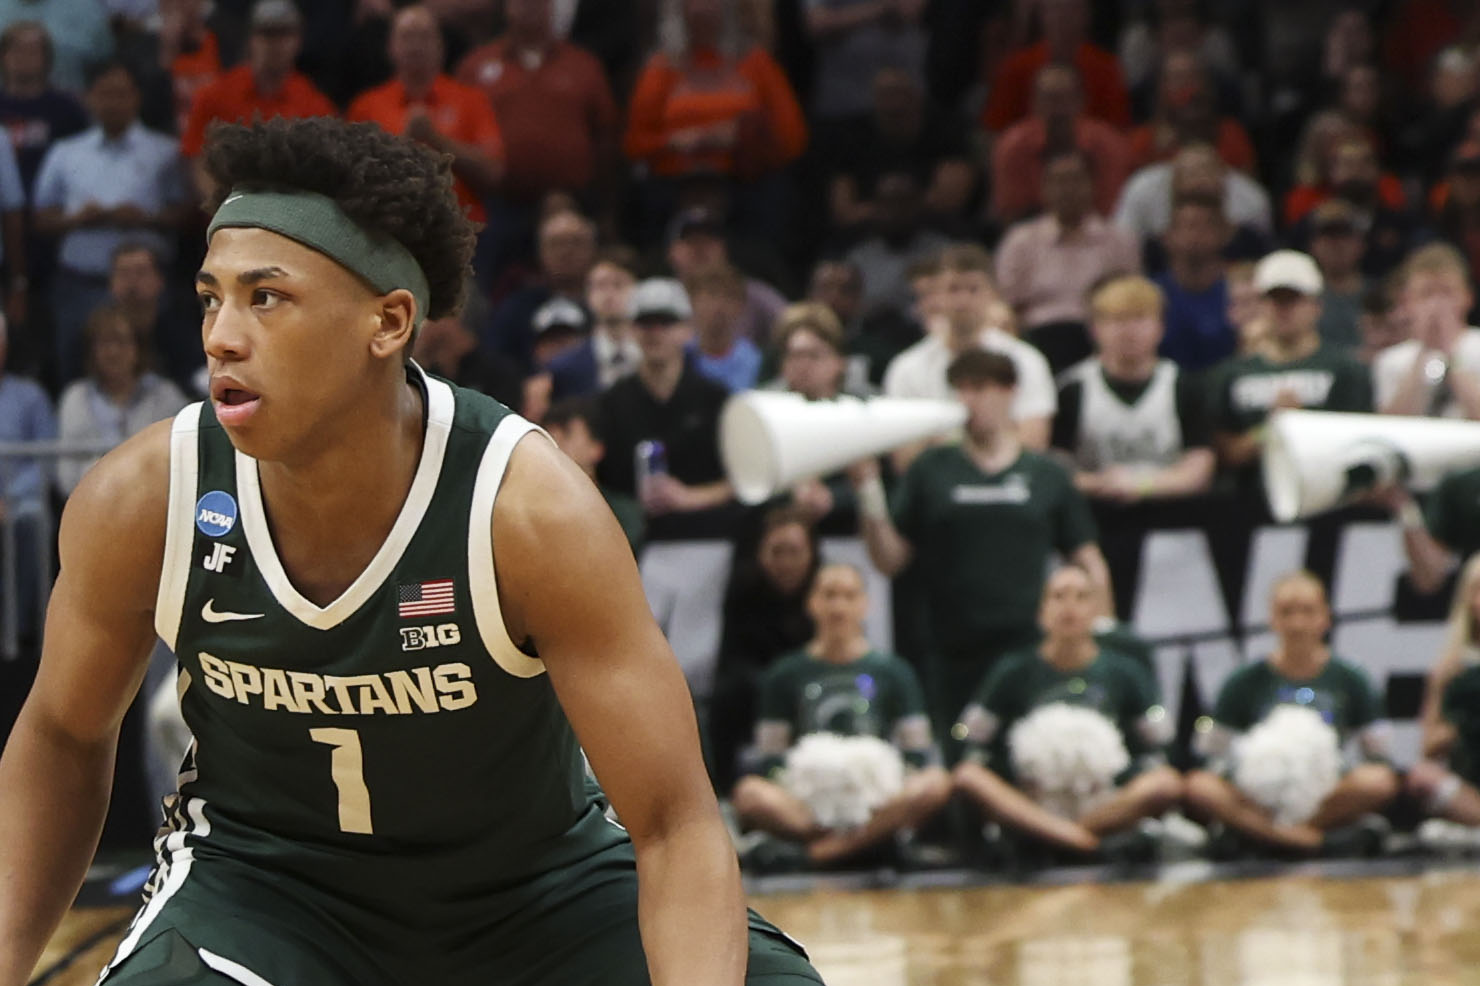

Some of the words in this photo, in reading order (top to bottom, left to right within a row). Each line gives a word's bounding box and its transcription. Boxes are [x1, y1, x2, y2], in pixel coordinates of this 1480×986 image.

[199, 508, 233, 529] NCAA
[203, 541, 237, 573] JF
[198, 651, 478, 715] SPARTANS
[309, 727, 373, 834] 1
